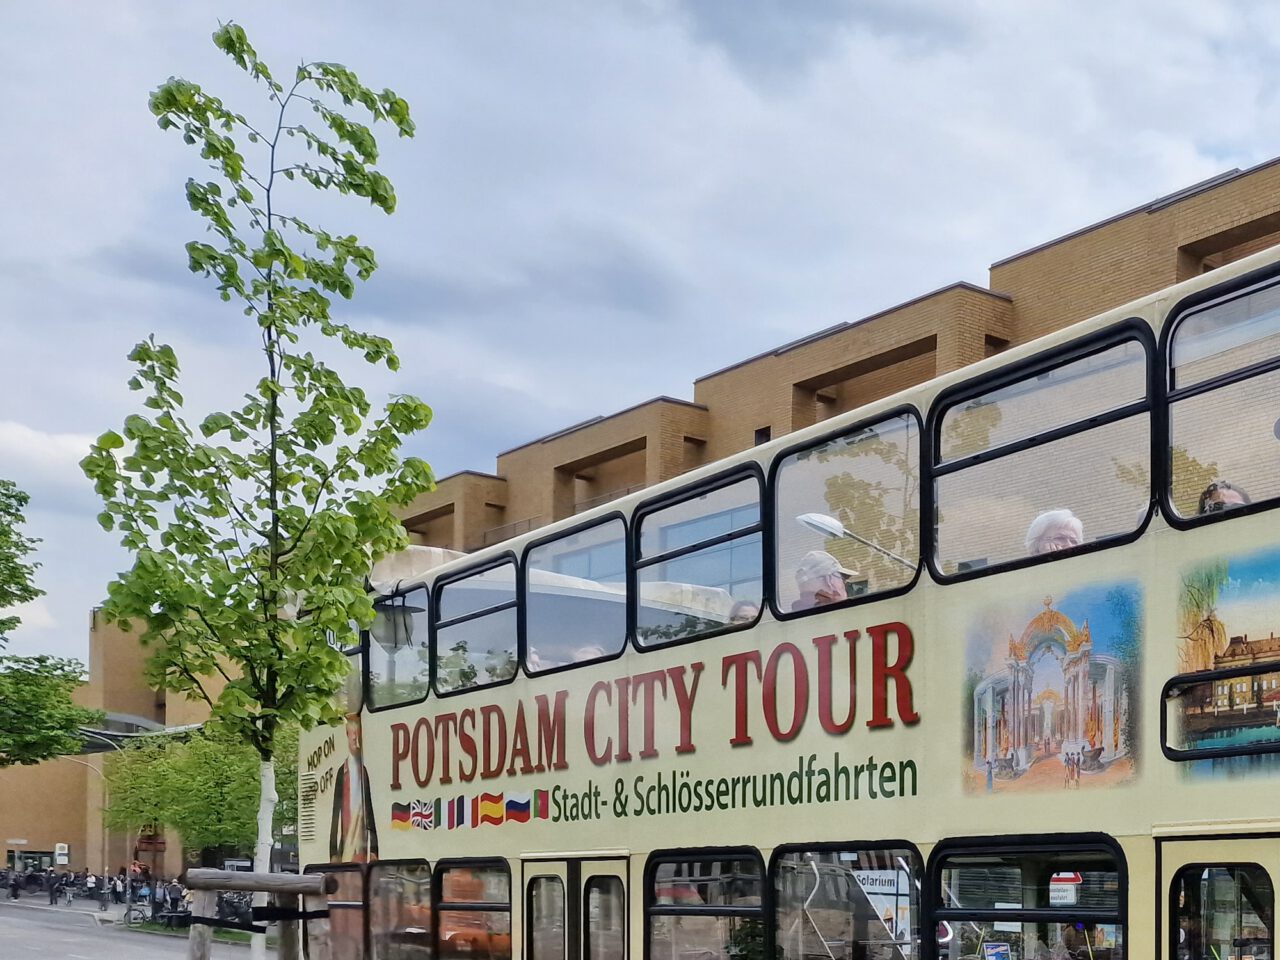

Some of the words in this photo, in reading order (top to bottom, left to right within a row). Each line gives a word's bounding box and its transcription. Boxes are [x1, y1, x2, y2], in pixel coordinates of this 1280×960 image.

[389, 690, 569, 790] POTSDAM
[583, 662, 704, 767] CITY
[722, 621, 921, 747] TOUR
[307, 746, 322, 772] HOP
[323, 734, 336, 758] ON
[320, 767, 334, 793] OFF
[552, 780, 608, 823] Stadt-
[612, 778, 629, 818] &
[634, 752, 919, 817] Schlösserrundfahrten
